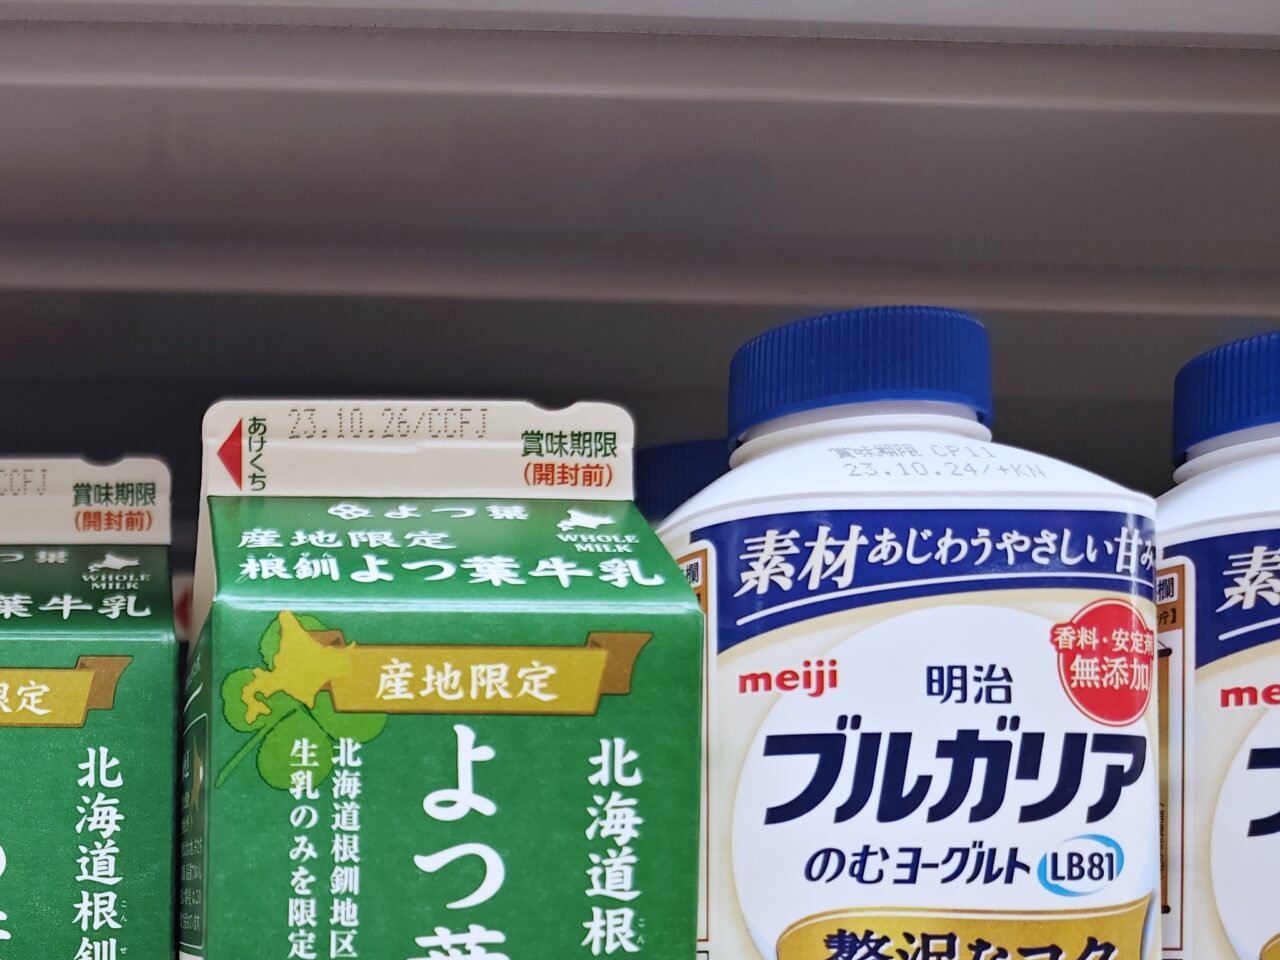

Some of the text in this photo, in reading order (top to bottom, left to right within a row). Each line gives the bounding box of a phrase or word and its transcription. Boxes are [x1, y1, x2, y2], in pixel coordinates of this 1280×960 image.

[247, 416, 267, 491] あけくち
[521, 430, 618, 458] 賞味期限
[523, 462, 614, 487] (開封前)
[72, 482, 157, 508] 賞味期限
[74, 510, 154, 532] (開封前)
[383, 504, 530, 520] よつ葉
[236, 528, 458, 549] 産地限定
[555, 533, 640, 544] WHOLE
[575, 543, 634, 553] MILK
[80, 573, 151, 582] WHOLE
[90, 582, 140, 590] MILK
[237, 555, 666, 588] 根釧よつ葉牛乳
[1215, 545, 1280, 614] 素
[375, 657, 559, 701] 産地限定
[738, 659, 839, 698] meiji
[926, 663, 1013, 704] 明治
[1069, 656, 1151, 692] 無添加
[763, 713, 1147, 826] ブルガリア
[804, 840, 1031, 885] のむヨーグルト
[1050, 851, 1117, 882] LB81
